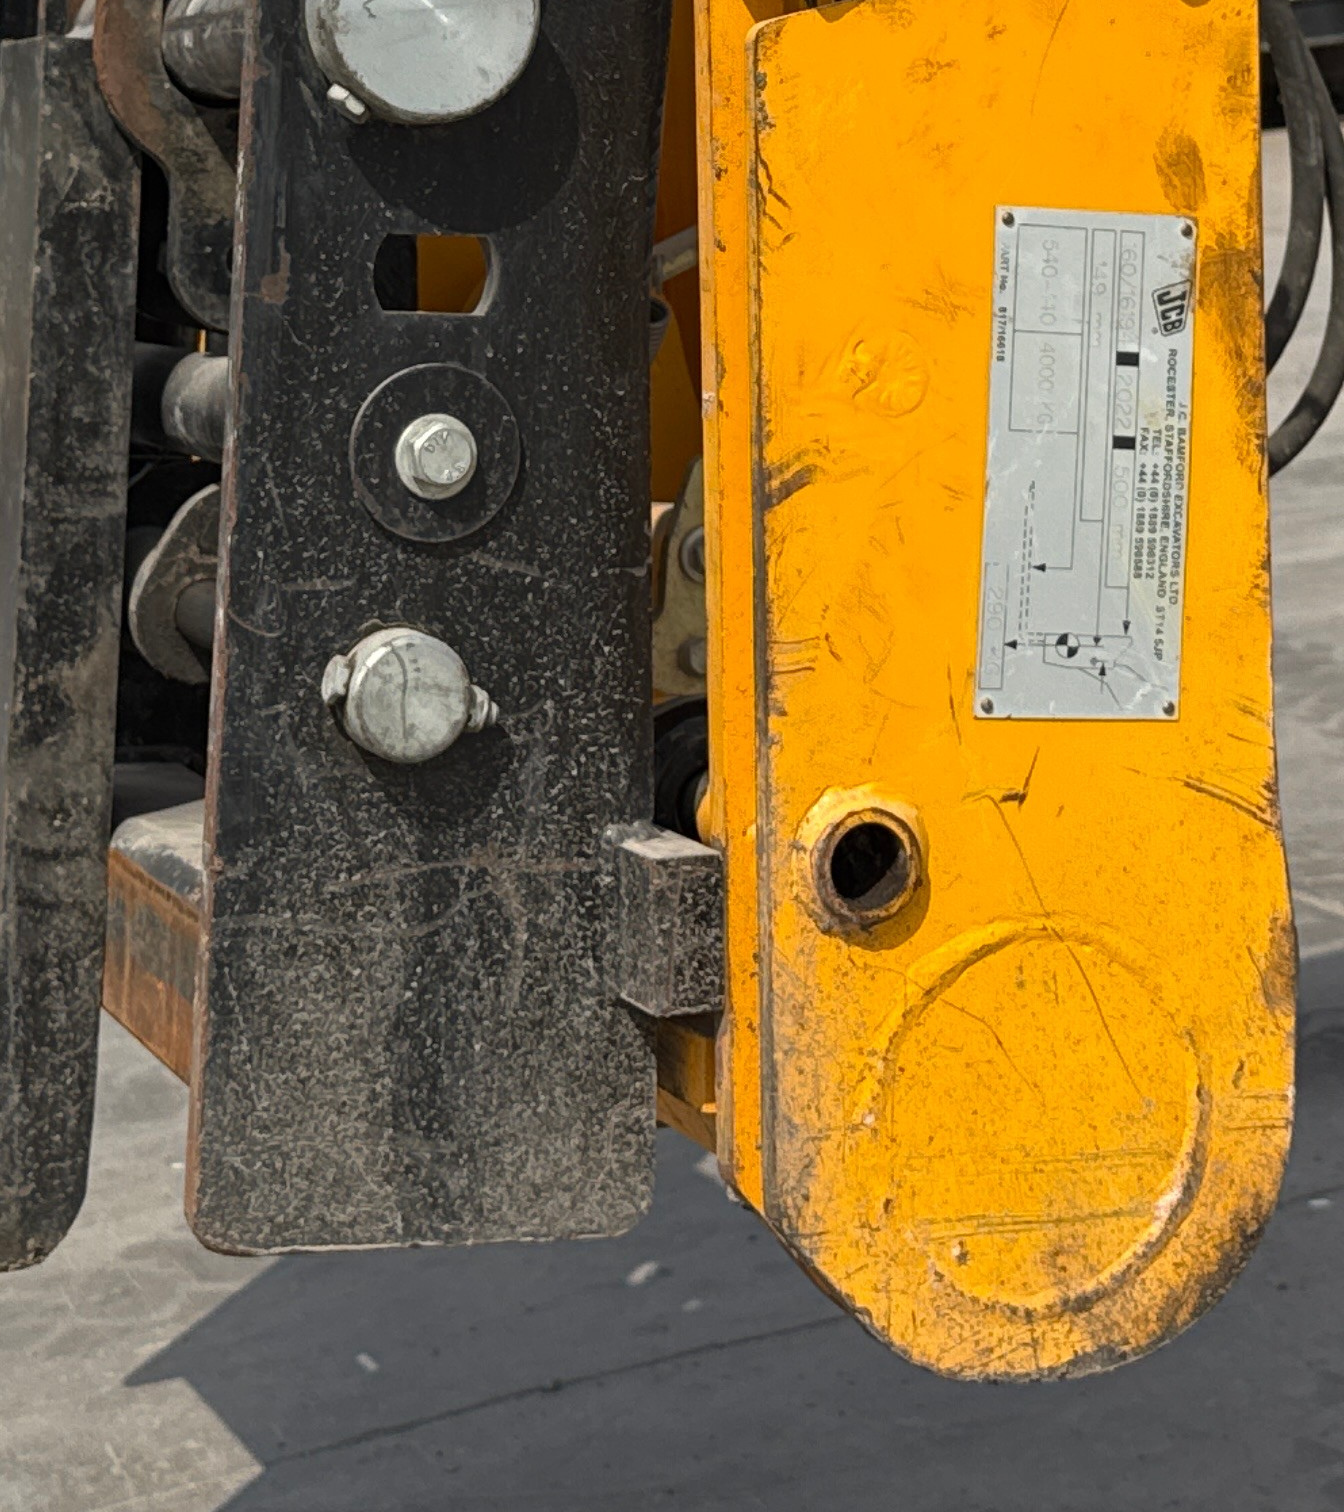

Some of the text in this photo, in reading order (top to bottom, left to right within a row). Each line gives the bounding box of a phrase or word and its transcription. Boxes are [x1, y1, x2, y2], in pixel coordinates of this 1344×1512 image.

[1155, 288, 1188, 334] JCB
[1038, 342, 1056, 392] 4000
[1116, 374, 1133, 430] 2022
[1175, 427, 1187, 491] BAMFORD
[1112, 466, 1130, 508] 500
[1135, 487, 1147, 502] (0)
[1148, 487, 1159, 502] (0)
[1170, 494, 1184, 578] EXCAVATORS
[1157, 536, 1169, 599] ENGLAND
[1155, 605, 1166, 635] ST14
[1153, 638, 1164, 661] 5JP
